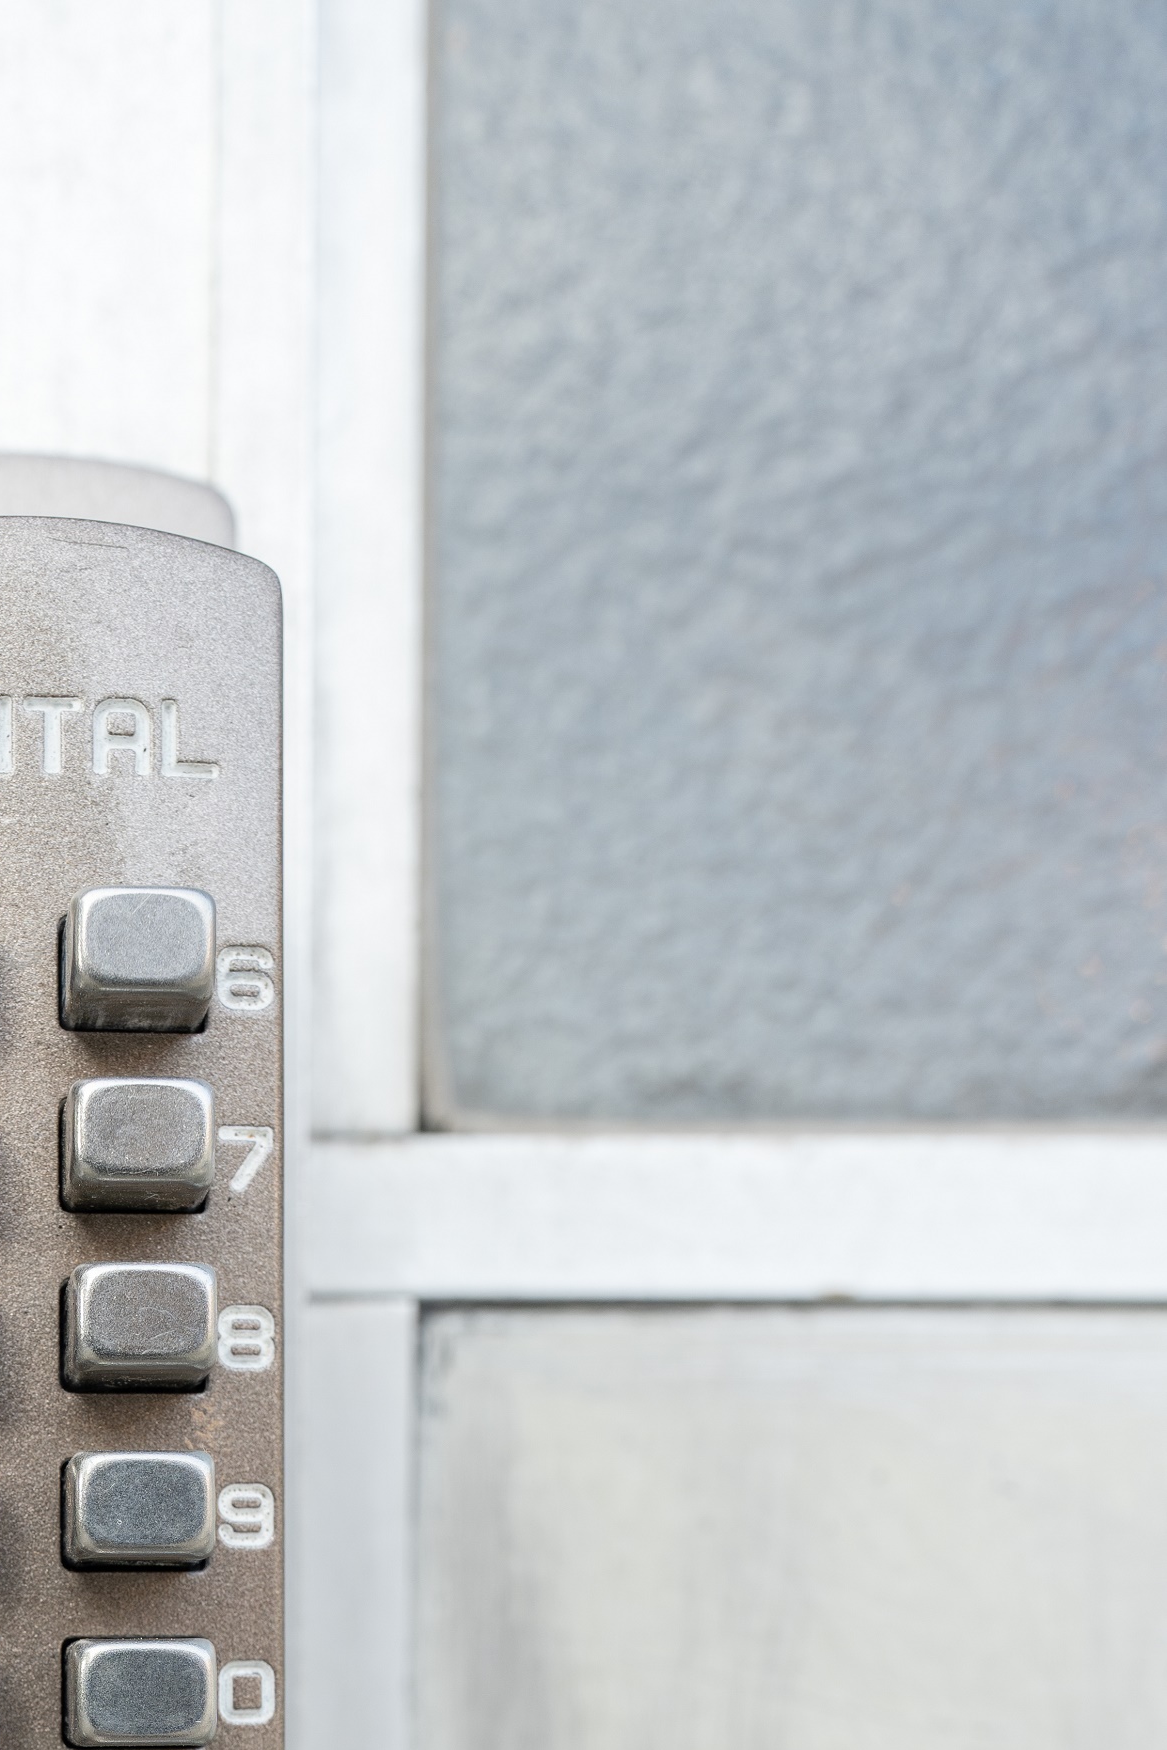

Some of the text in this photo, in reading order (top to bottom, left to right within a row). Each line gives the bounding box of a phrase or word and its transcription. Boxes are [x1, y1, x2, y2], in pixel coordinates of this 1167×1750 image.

[216, 945, 275, 1010] 6
[217, 1126, 274, 1194] 7
[217, 1304, 275, 1371] 8
[217, 1483, 275, 1549] 9
[218, 1660, 276, 1725] 0
